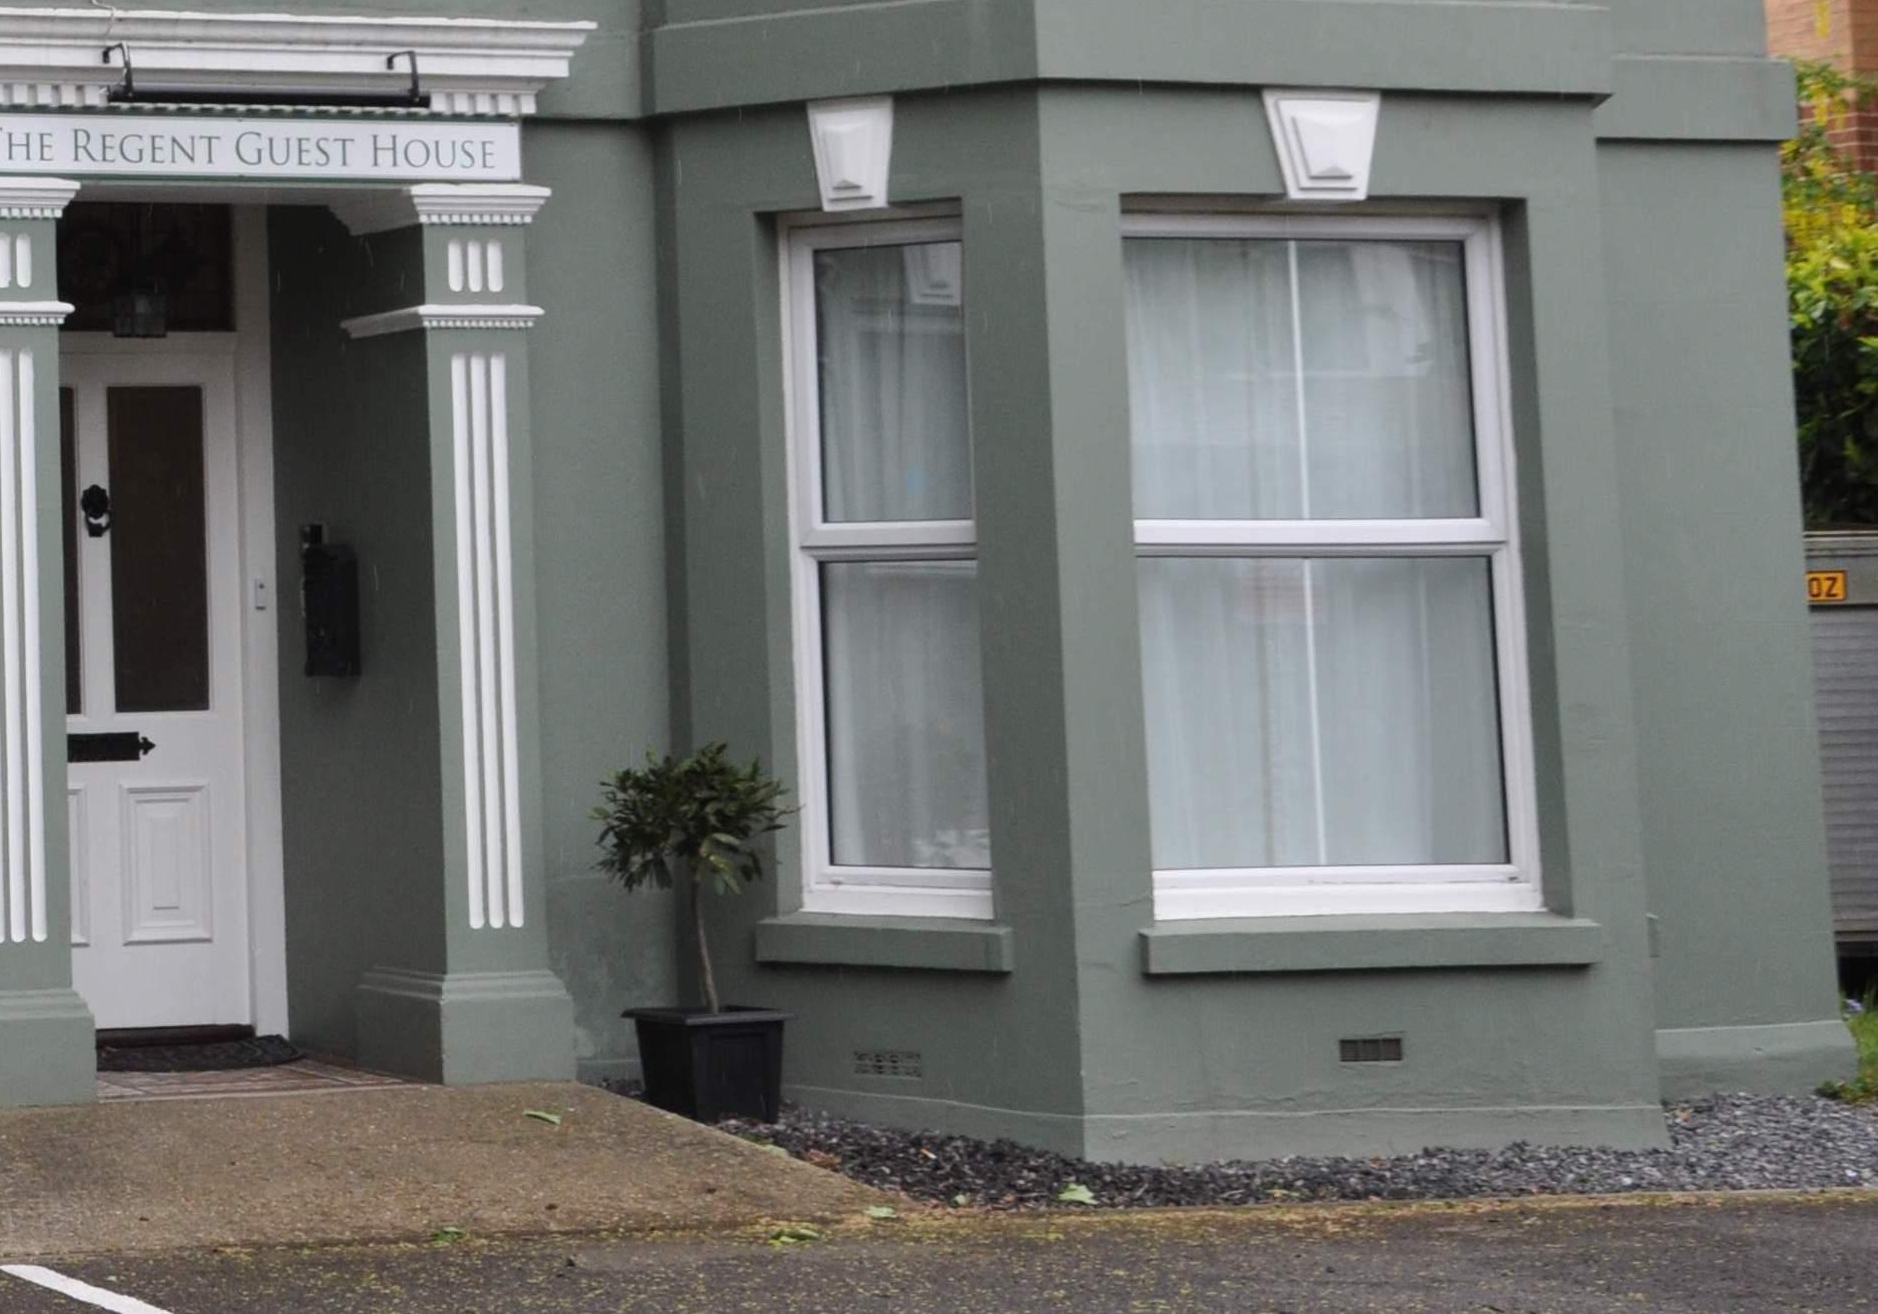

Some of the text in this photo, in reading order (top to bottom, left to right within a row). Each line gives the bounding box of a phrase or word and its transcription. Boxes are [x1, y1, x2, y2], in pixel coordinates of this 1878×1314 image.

[72, 128, 222, 164] REGENT
[234, 131, 356, 167] GUEST
[371, 134, 496, 169] HOUSE
